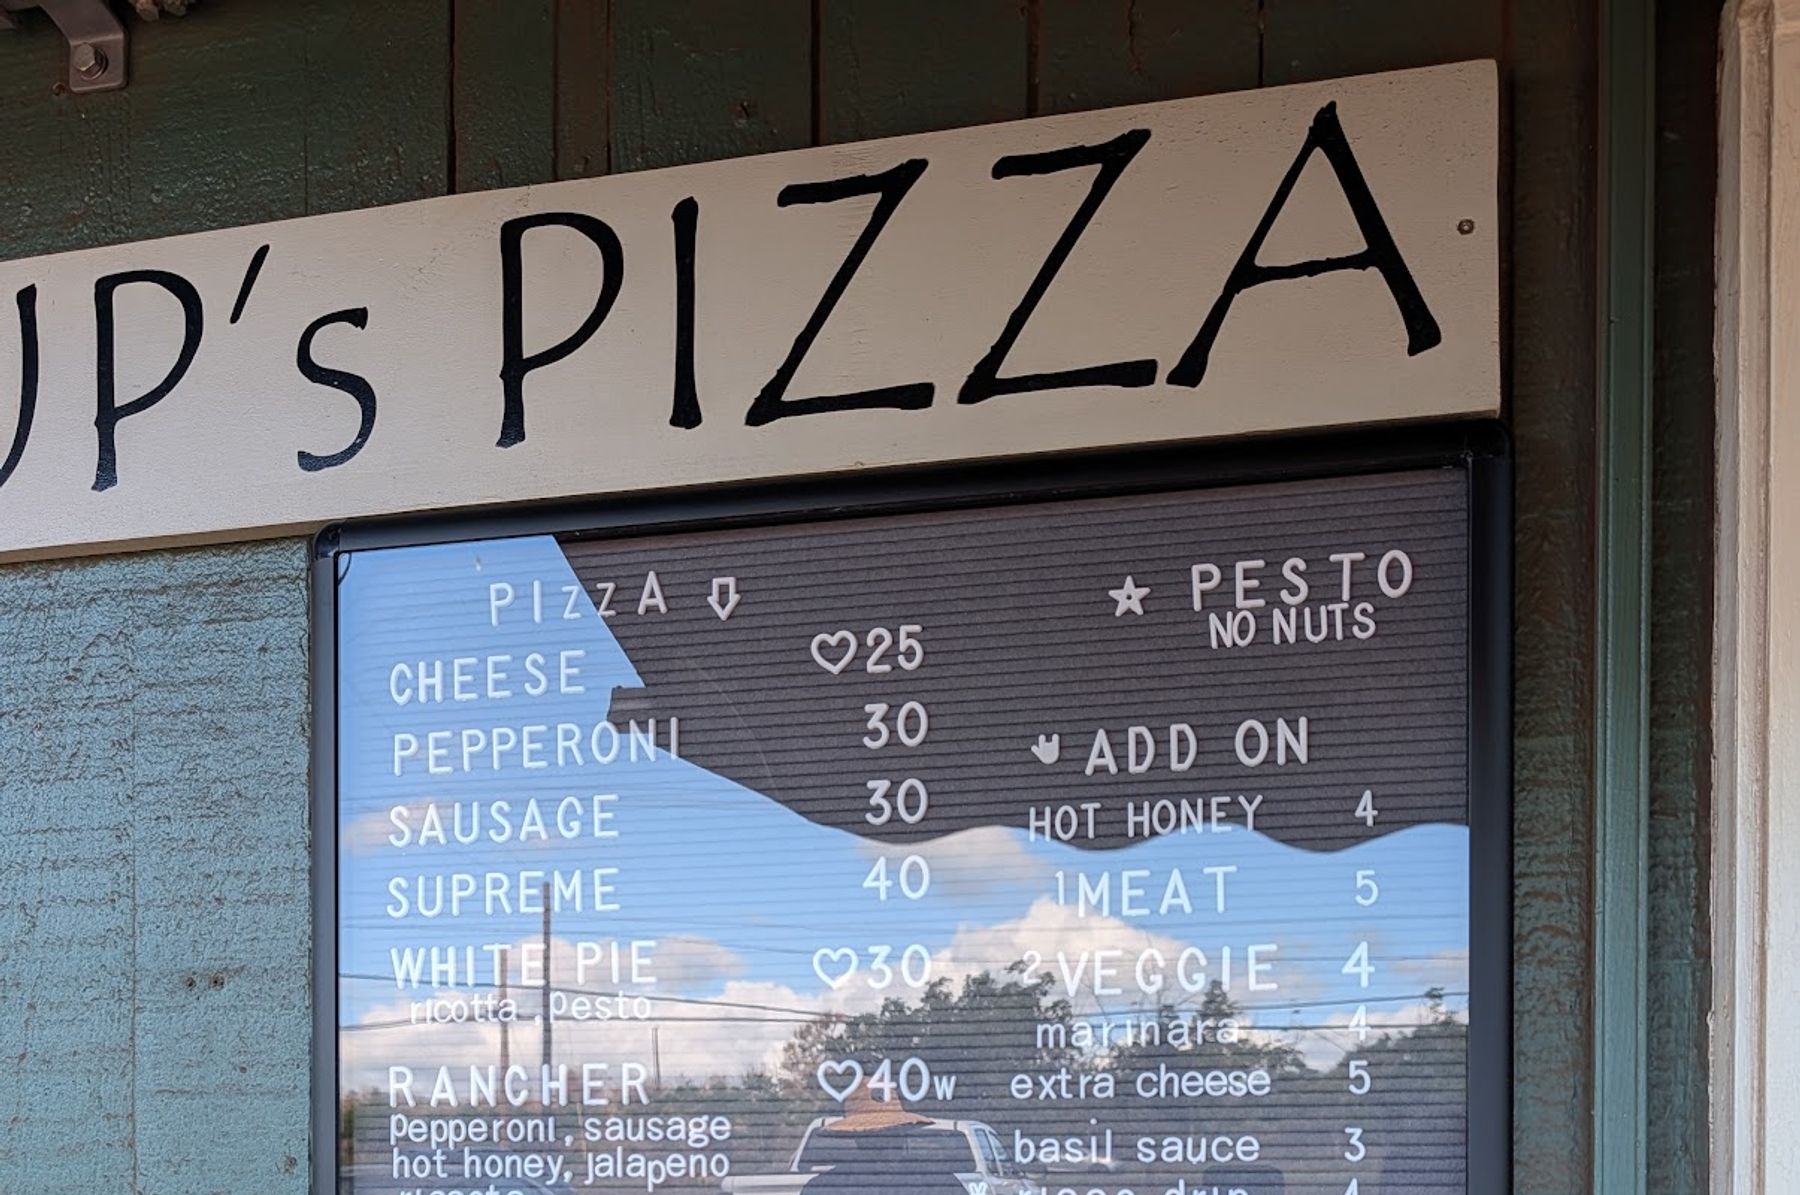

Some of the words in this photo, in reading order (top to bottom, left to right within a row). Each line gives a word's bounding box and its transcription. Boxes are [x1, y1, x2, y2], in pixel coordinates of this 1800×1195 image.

[496, 101, 1441, 447] PIZZA
[1192, 550, 1412, 611] PESTO
[866, 625, 923, 673] 25
[1209, 611, 1255, 649] NO
[1273, 602, 1376, 644] NUTS
[390, 650, 585, 706] CHEESE
[394, 717, 679, 776] PEPPERONI
[863, 701, 928, 749] 30
[1085, 724, 1197, 775] ADD
[1235, 717, 1308, 768] ON
[389, 795, 619, 848] SAUSAGE
[865, 778, 928, 825] 30
[1029, 803, 1101, 842] HOT
[1128, 795, 1263, 838] HONEY
[1355, 790, 1377, 826] 4
[387, 868, 620, 918] SUPREME
[863, 855, 929, 900] 40
[1355, 870, 1378, 906] 5
[391, 943, 546, 989] WHITE
[577, 941, 657, 985] PIE
[866, 944, 931, 990] 30
[1342, 941, 1375, 988] 4
[1036, 1016, 1238, 1049] marinara
[1348, 1006, 1371, 1040] 4
[388, 1062, 651, 1108] RANCHER
[1010, 1068, 1114, 1099] extra
[1136, 1063, 1270, 1097] cheese
[1349, 1060, 1371, 1095] 5
[584, 1115, 731, 1147] sausage
[1014, 1119, 1112, 1164] basil
[1136, 1134, 1260, 1165] sauce
[1344, 1128, 1366, 1162] 3
[392, 1147, 447, 1178] hot
[464, 1147, 573, 1185] honey,
[584, 1147, 729, 1192] jalapeno
